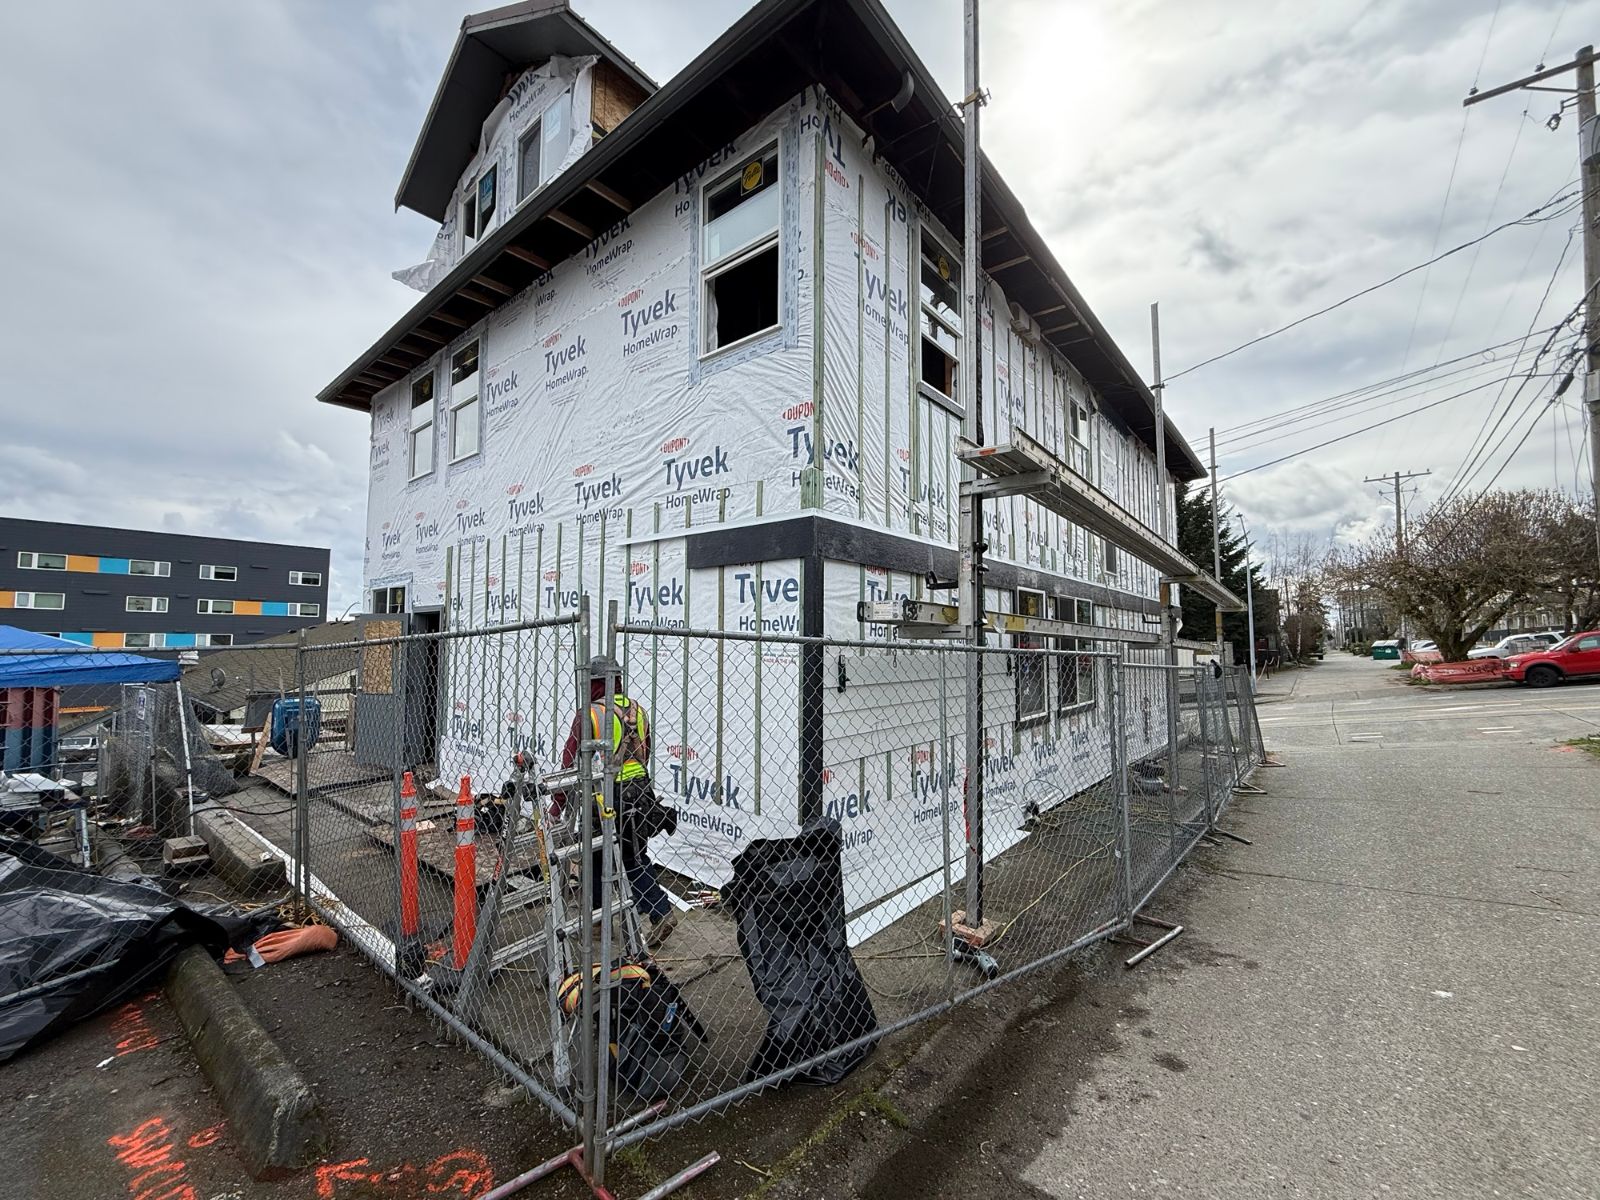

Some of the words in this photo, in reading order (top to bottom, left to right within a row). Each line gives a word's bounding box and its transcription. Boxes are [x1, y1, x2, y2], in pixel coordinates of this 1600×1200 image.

[509, 83, 546, 122] HomeWrap
[619, 288, 643, 307] DUPONT
[854, 252, 908, 320] yvek
[621, 290, 677, 338] Tyvek
[545, 335, 586, 375] Tyvek
[623, 324, 678, 357] HomeWrap
[486, 371, 518, 402] Tyvek
[546, 365, 588, 391] HomeWrap
[486, 397, 518, 418] HomeWrap
[786, 402, 815, 420] DUPON
[661, 438, 689, 453] DUPONT
[663, 446, 729, 490] Tyvek
[575, 473, 622, 510] Tyvek
[457, 507, 485, 534] Tyvek
[508, 492, 544, 523] Tyvek
[382, 530, 401, 550] Tyvek
[416, 519, 439, 542] Tyvek
[509, 523, 545, 537] HomeWrap
[545, 583, 584, 609] Tyve
[735, 573, 799, 612] Tyve
[668, 744, 698, 760] DUPNT
[984, 748, 1015, 782] Tyvek
